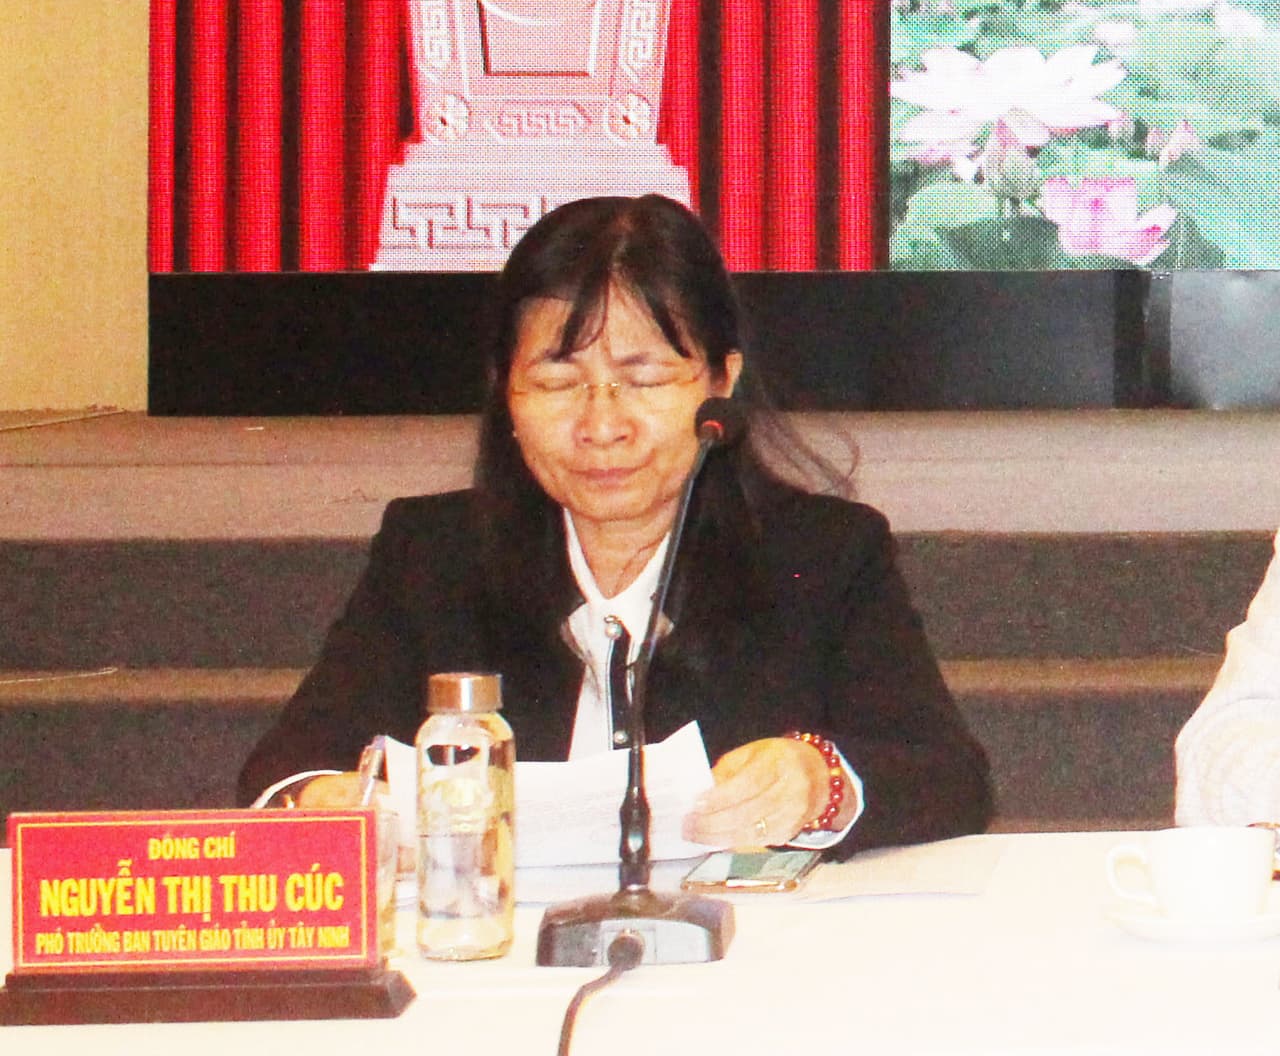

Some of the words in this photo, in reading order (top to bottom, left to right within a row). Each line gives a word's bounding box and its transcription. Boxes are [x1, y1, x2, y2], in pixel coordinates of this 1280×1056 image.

[203, 831, 236, 859] CHÍ
[40, 859, 156, 917] NGUYỄN
[162, 876, 213, 923] THỊ
[219, 874, 278, 913] THU
[285, 863, 345, 912] CÚC
[35, 927, 64, 955] PHÓ
[66, 923, 120, 953] TRƯỞNG
[122, 929, 151, 953] BAN
[152, 924, 198, 952] TUYÊN
[199, 923, 231, 951] GIÁO
[233, 920, 265, 950] TỈNH
[266, 919, 287, 949] ỦY
[287, 922, 315, 949] TÂY
[316, 926, 350, 948] NINH
